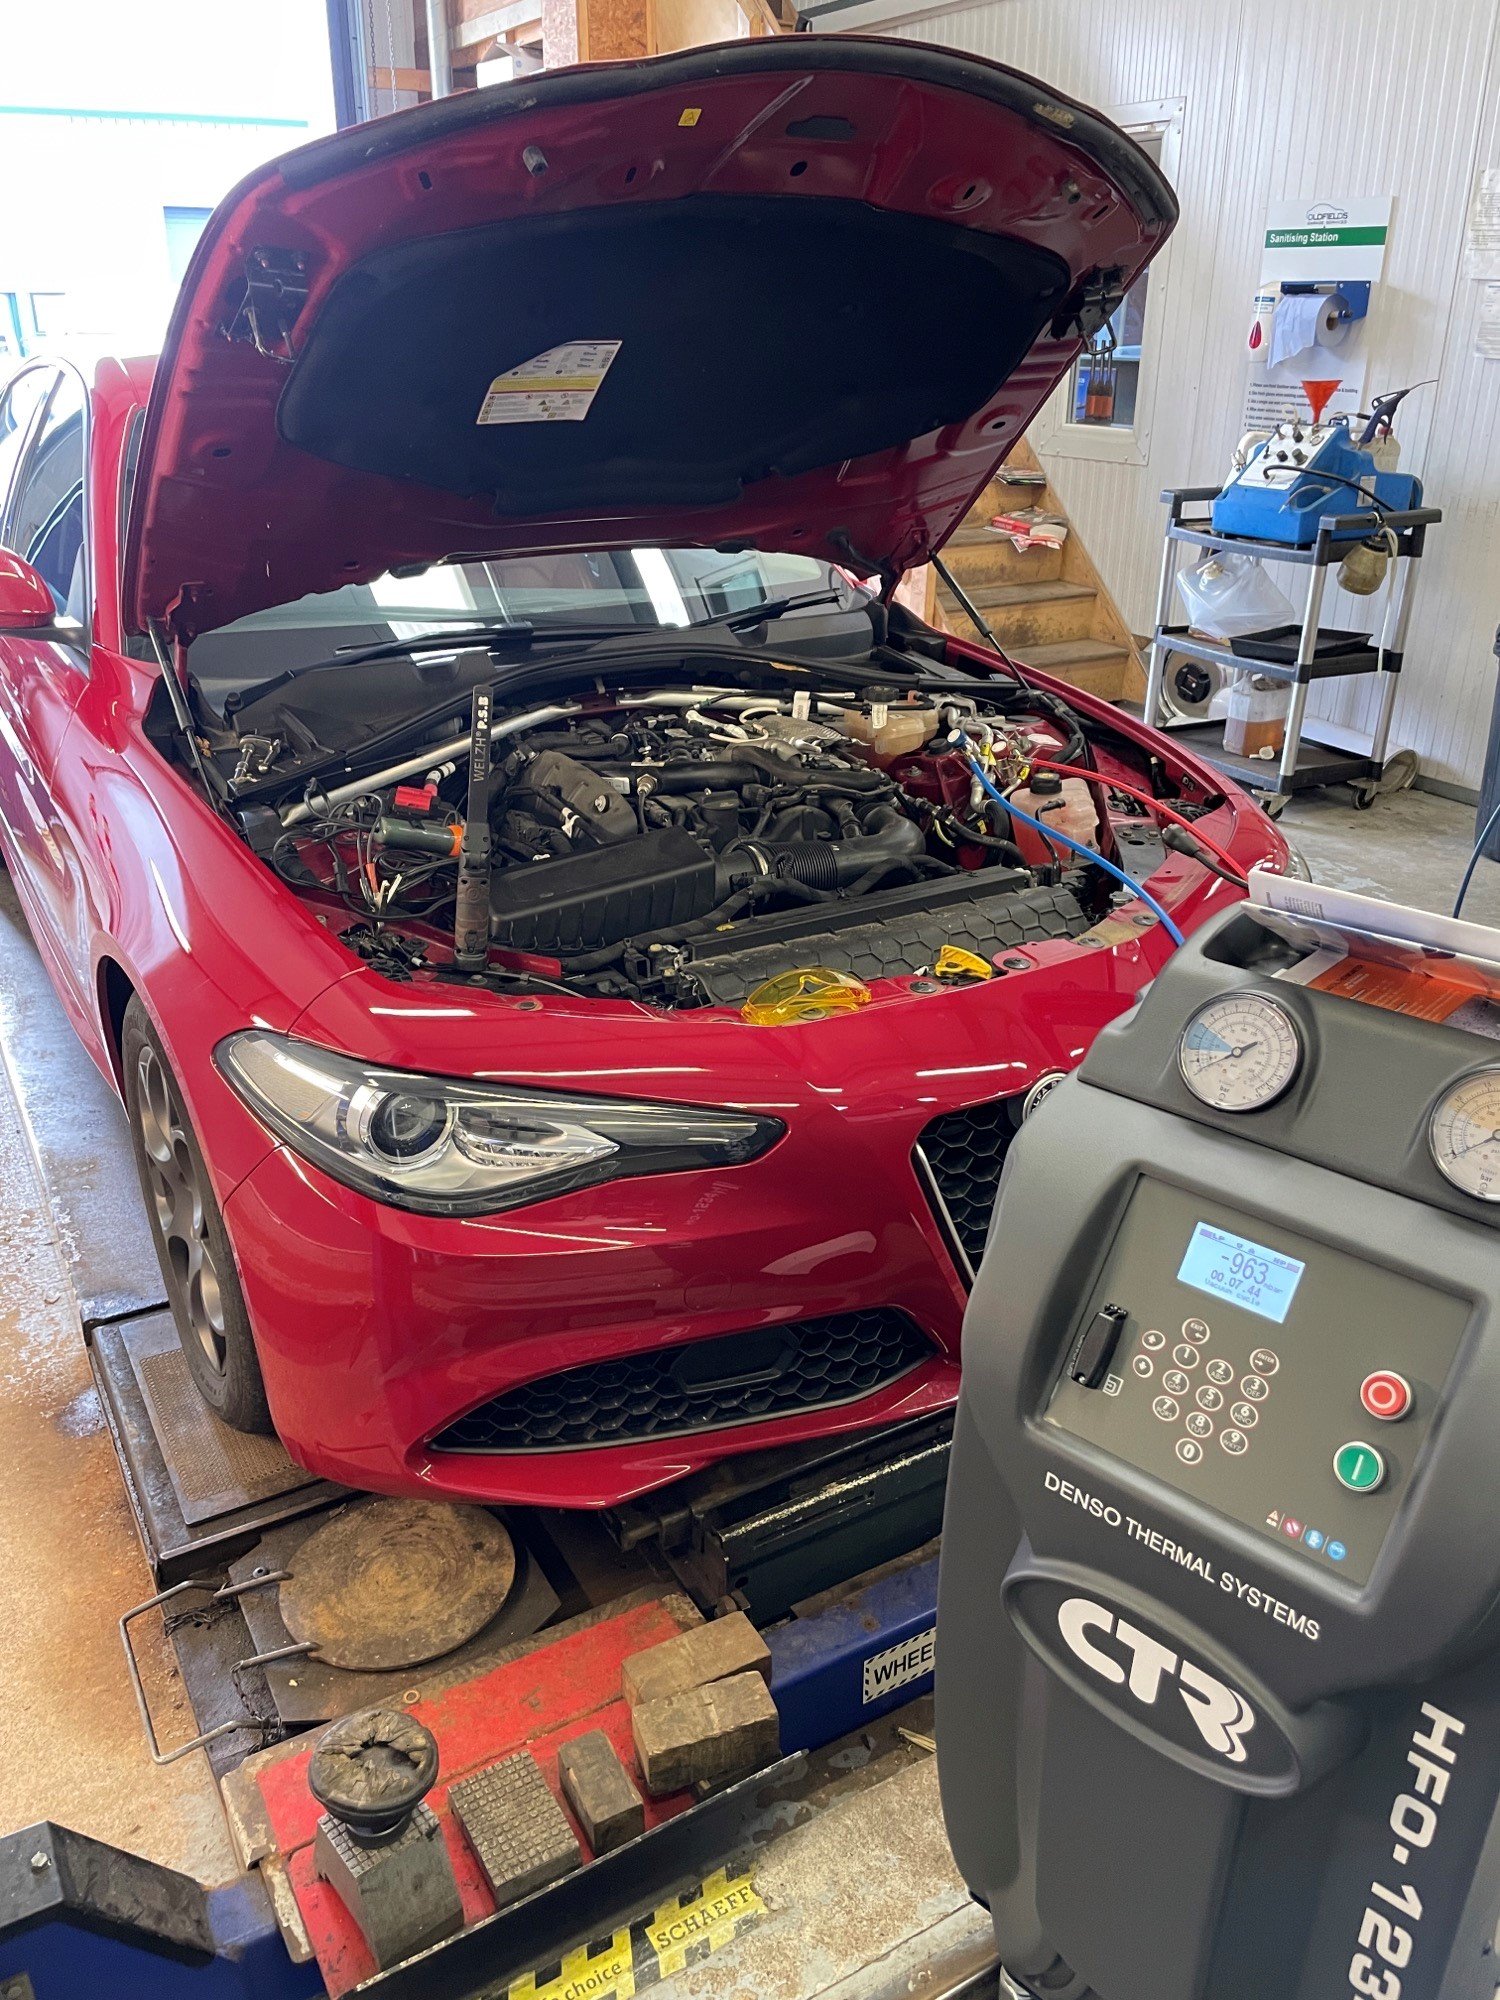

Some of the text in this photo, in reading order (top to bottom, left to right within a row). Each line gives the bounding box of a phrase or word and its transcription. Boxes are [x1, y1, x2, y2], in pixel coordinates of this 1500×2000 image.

[1306, 212, 1348, 221] OLDFIELDS
[1269, 232, 1339, 245] Sanitising Station
[1032, 1087, 1048, 1111] LFA
[1189, 1322, 1205, 1332] EXIT
[1257, 1352, 1275, 1364] ENTER
[1217, 1363, 1226, 1374] 2
[1172, 1373, 1182, 1385] 4
[1210, 1371, 1227, 1383] ABC
[1252, 1379, 1261, 1391] 3
[1206, 1390, 1216, 1400] 5
[1163, 1399, 1173, 1411] 7
[1240, 1406, 1251, 1418] 6
[1195, 1415, 1205, 1427] 8
[1233, 1412, 1253, 1426] MNO
[1230, 1432, 1241, 1444] 9
[1044, 1470, 1321, 1641] DENSO THERMAL SYSTEMS
[874, 1640, 936, 1686] WHEE
[1057, 1598, 1255, 1763] CTR
[656, 1885, 750, 1950] SCHAEFF
[564, 1962, 622, 2000] choice
